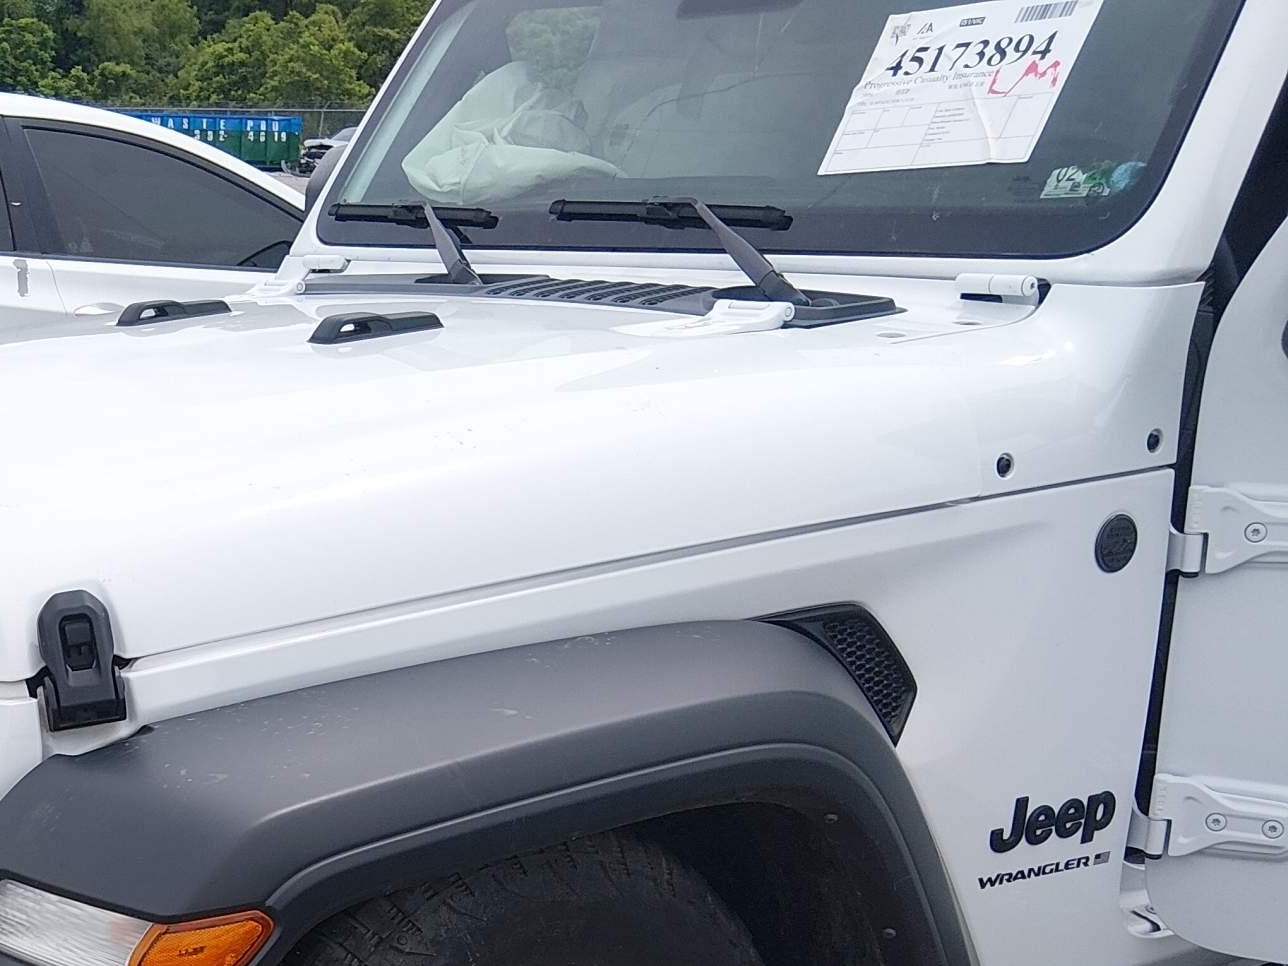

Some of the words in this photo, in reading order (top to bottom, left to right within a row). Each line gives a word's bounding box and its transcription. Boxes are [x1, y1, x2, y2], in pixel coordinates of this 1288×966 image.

[885, 30, 1059, 77] 45173894
[989, 790, 1116, 853] Jeep
[977, 855, 1090, 889] WRANGLER
